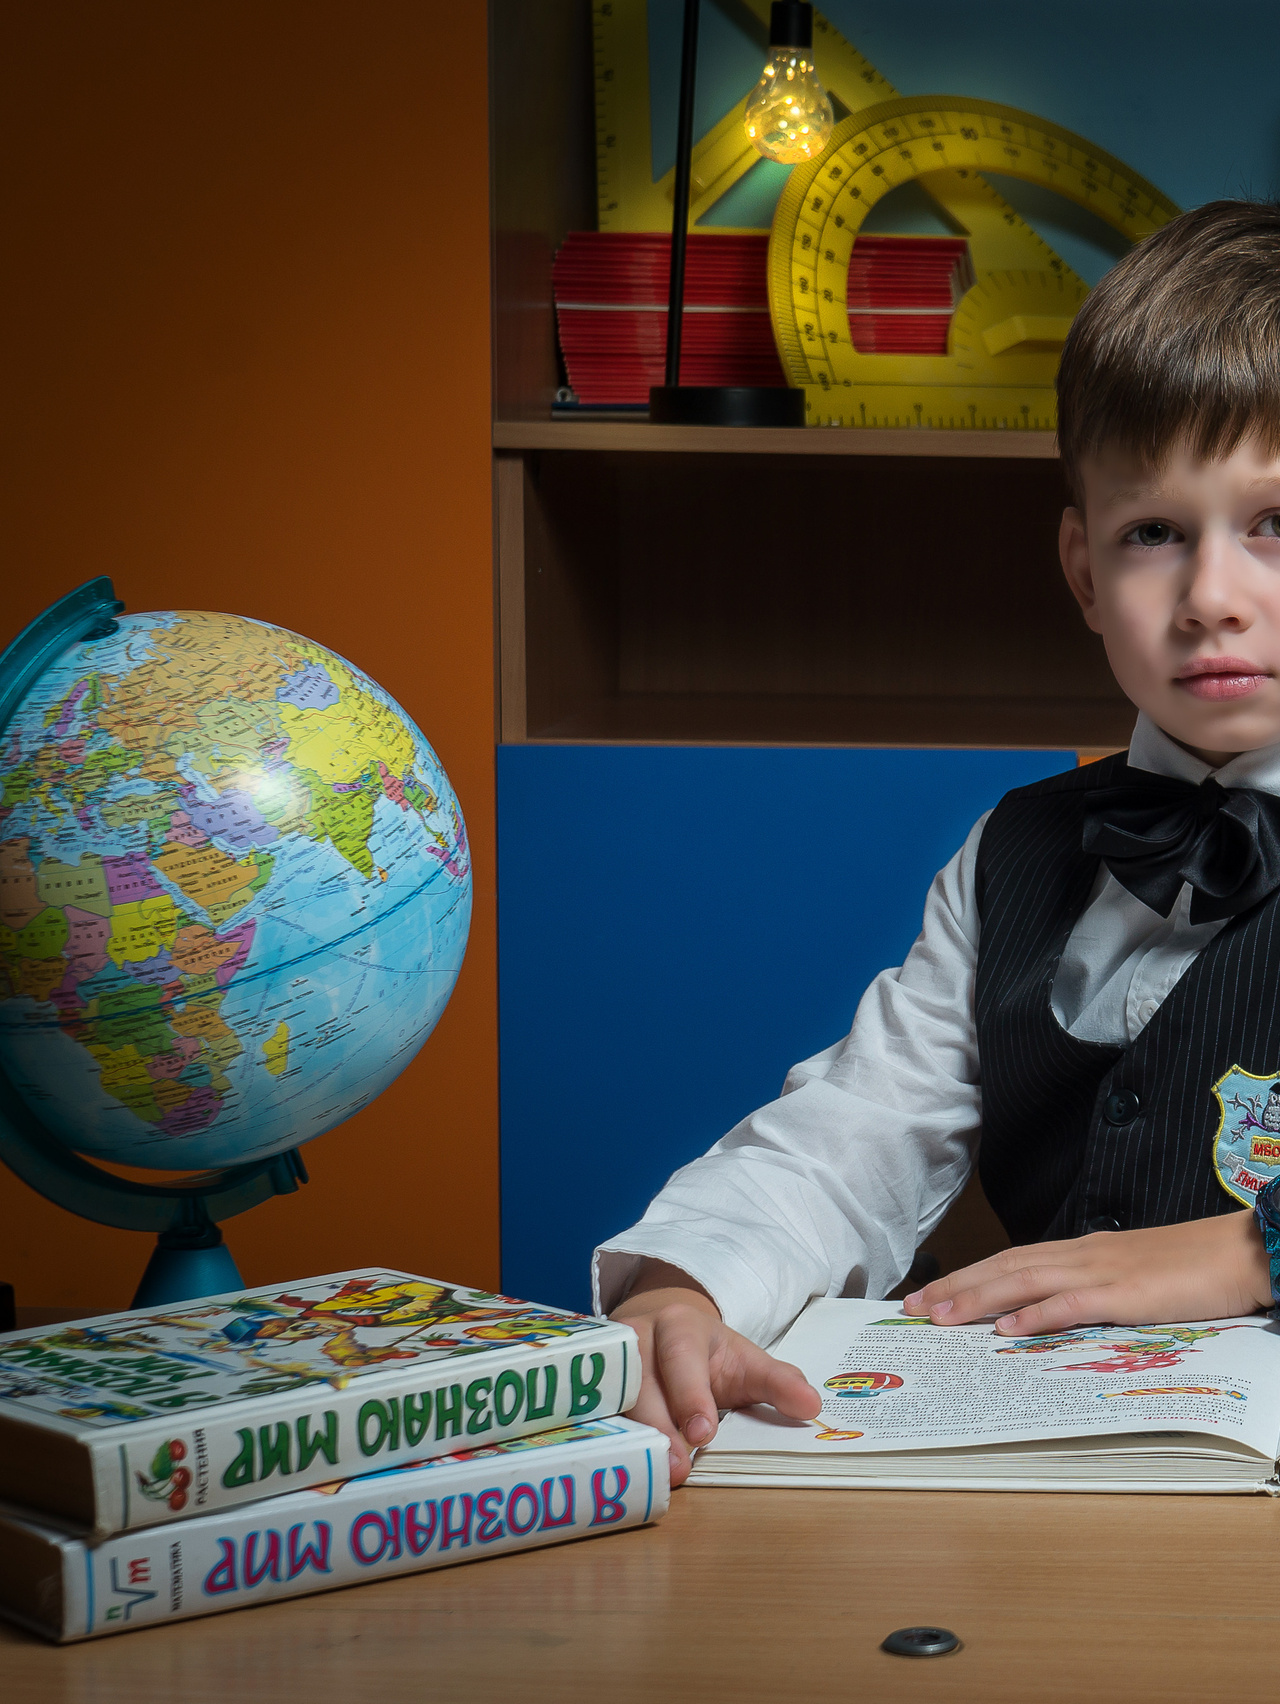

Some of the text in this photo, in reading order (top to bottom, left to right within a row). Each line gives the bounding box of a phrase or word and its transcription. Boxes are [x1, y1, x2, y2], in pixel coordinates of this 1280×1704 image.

[191, 1427, 209, 1507] РАСТЕНИЯ
[221, 1351, 606, 1489] Я ПОЗНАЮ МИР
[168, 1540, 184, 1614] МАТЕМАТИКА
[201, 1464, 633, 1598] Я ПОЗНАЮ МИР
